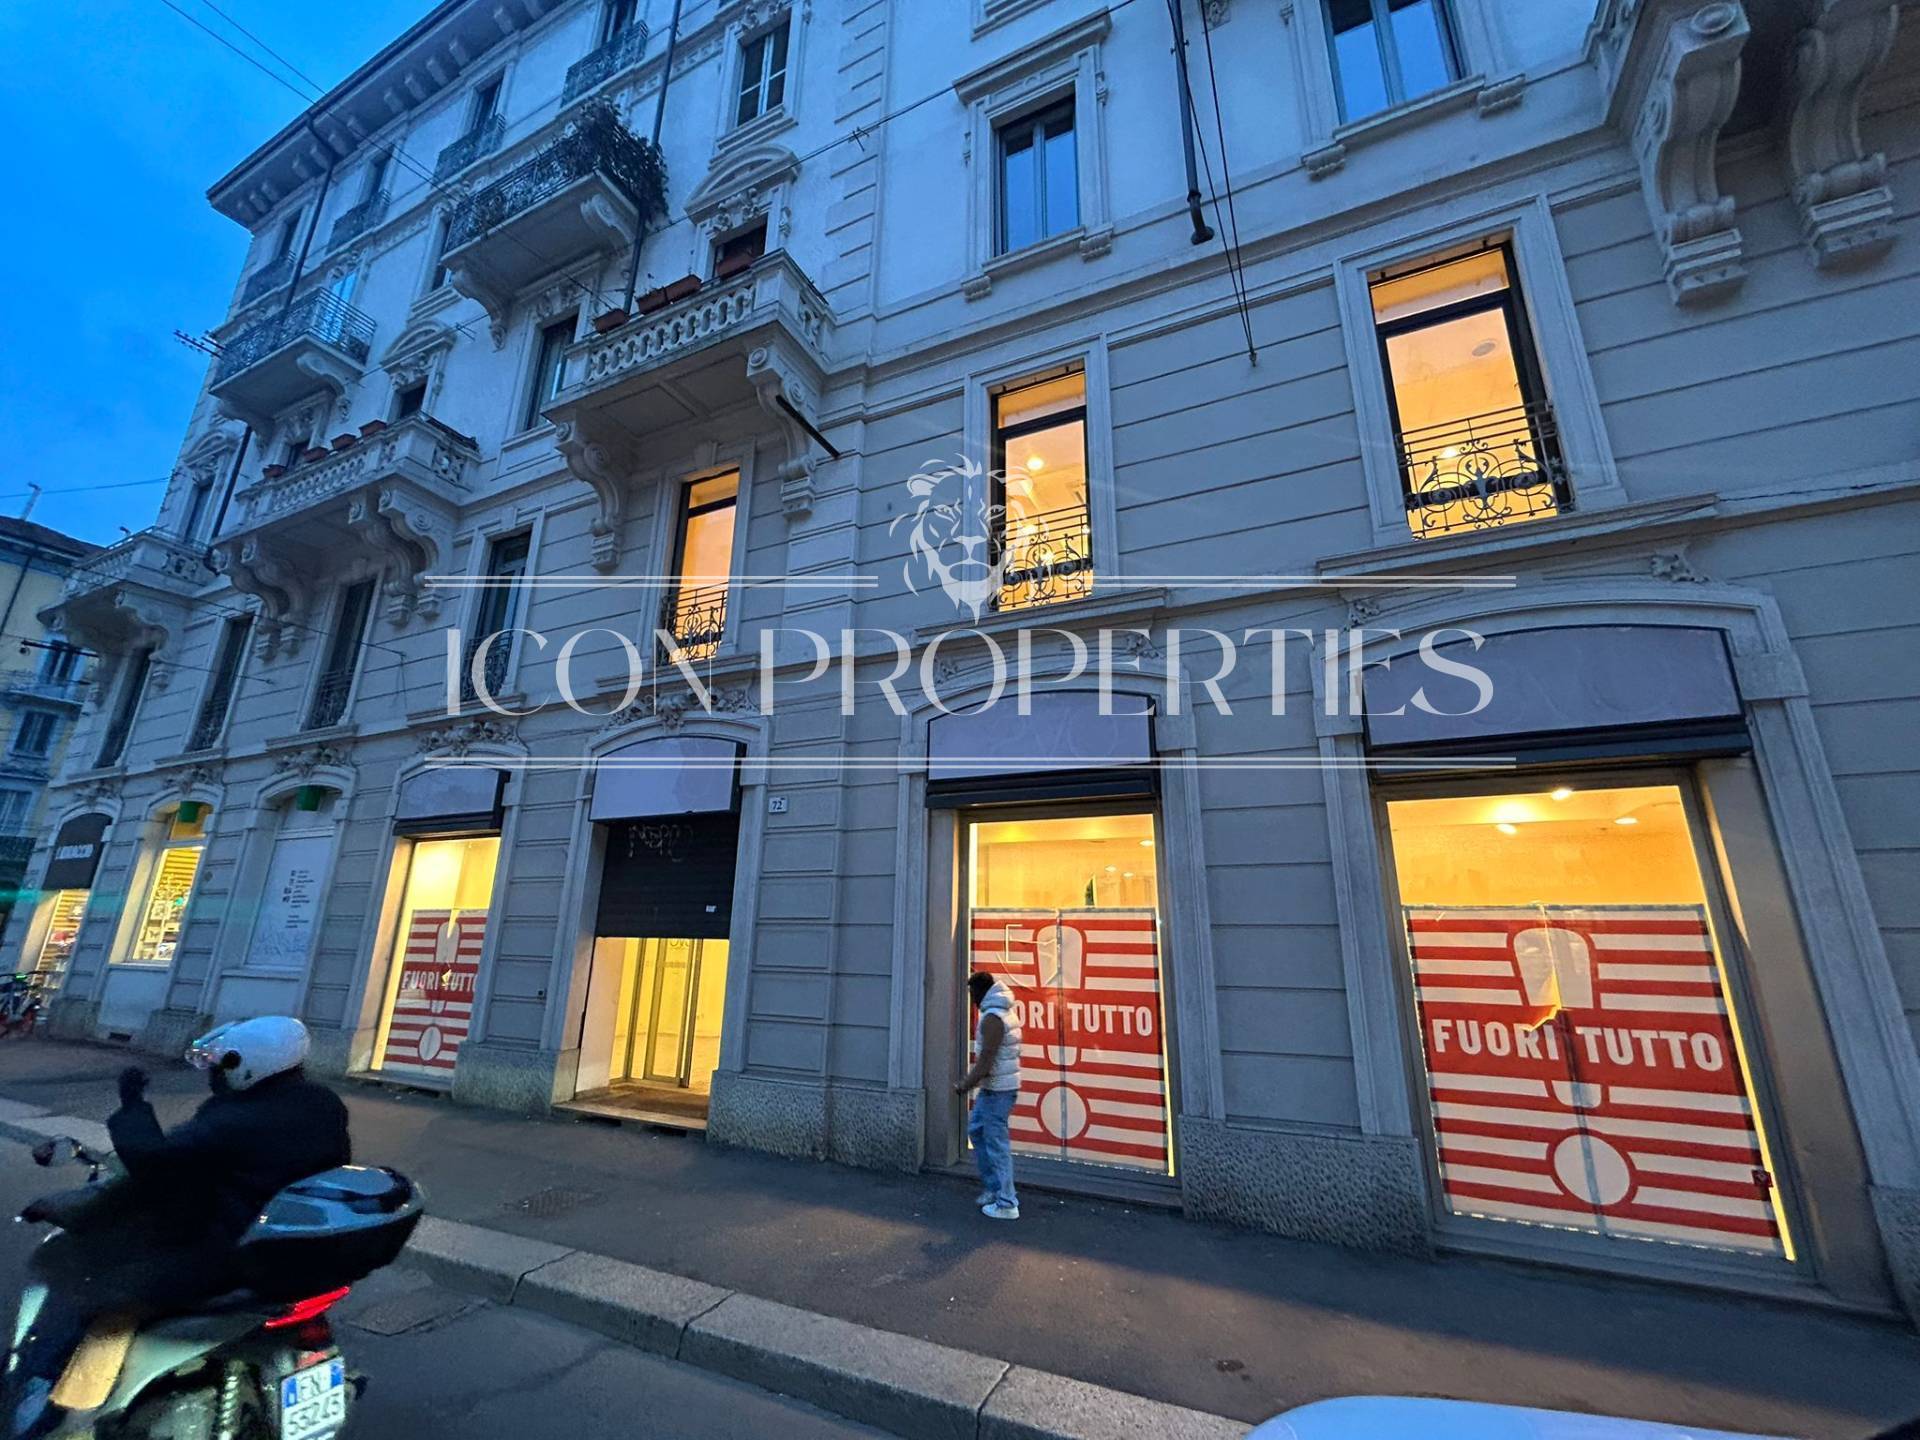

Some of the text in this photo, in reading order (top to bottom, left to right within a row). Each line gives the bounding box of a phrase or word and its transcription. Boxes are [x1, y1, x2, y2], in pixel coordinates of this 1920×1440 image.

[771, 800, 783, 810] 72
[402, 970, 440, 991] FUORI
[1067, 1002, 1153, 1037] TUTTO
[1432, 1018, 1724, 1072] FUORI TUTTO
